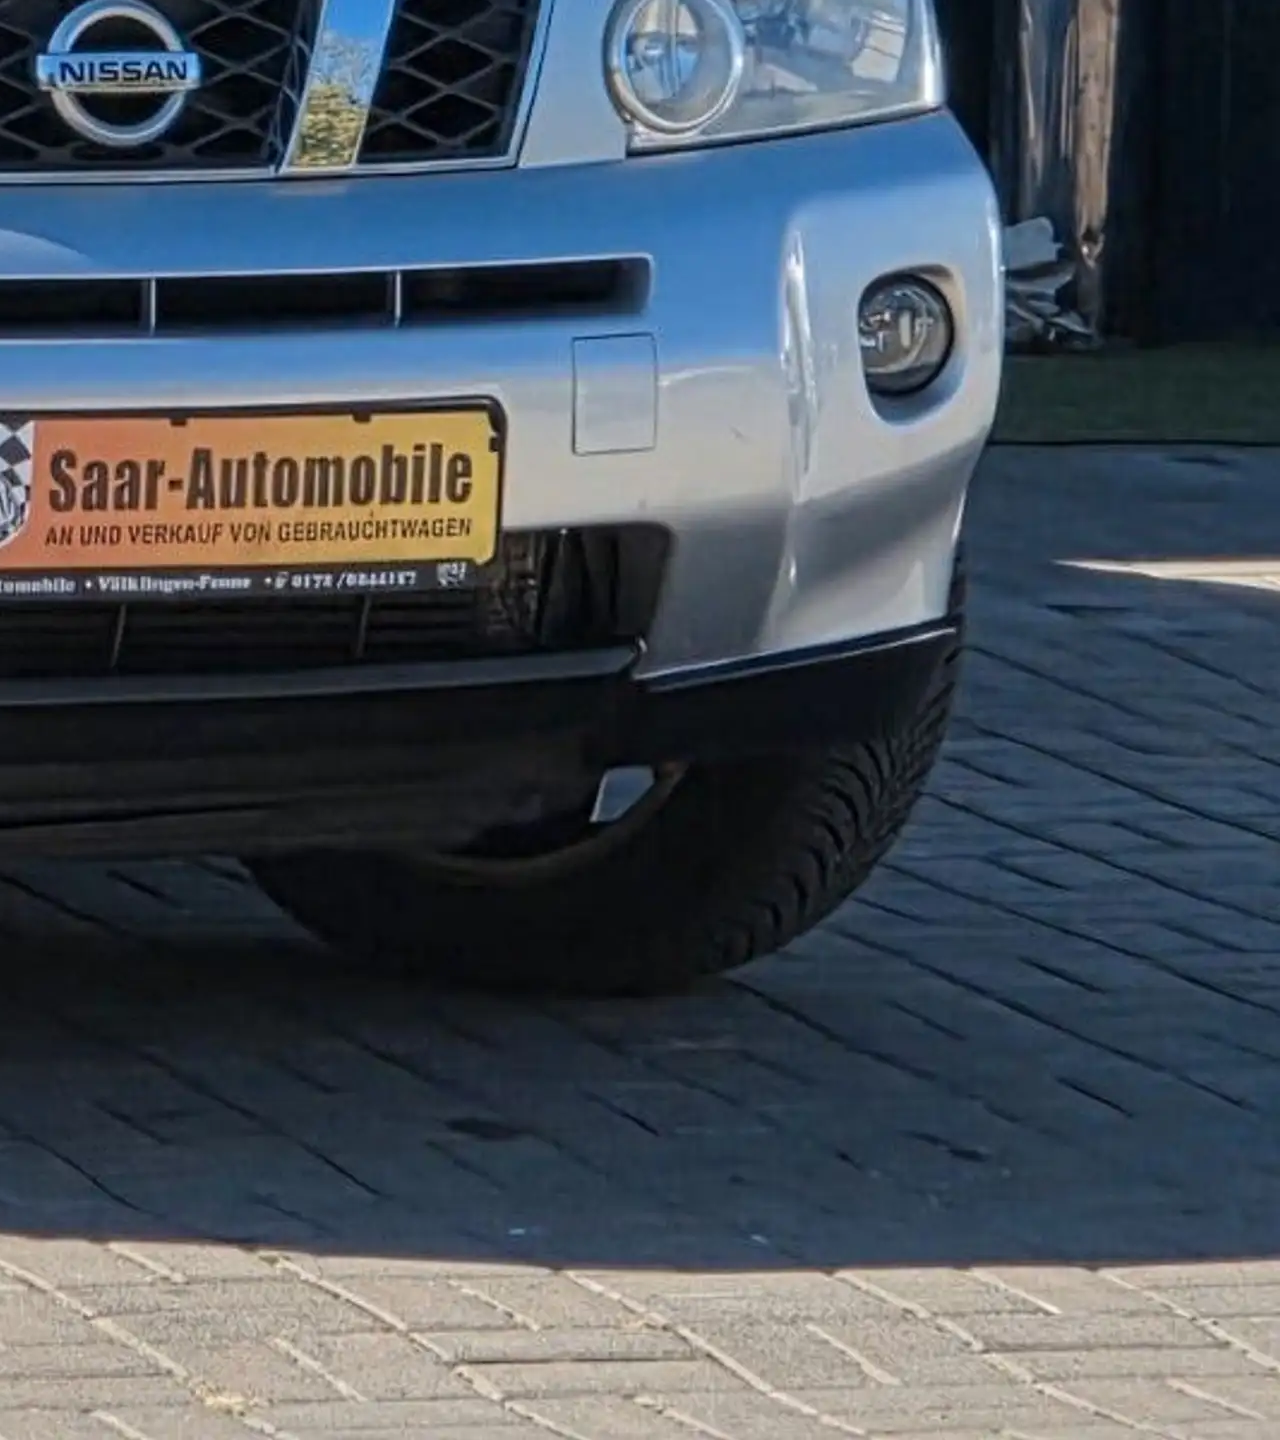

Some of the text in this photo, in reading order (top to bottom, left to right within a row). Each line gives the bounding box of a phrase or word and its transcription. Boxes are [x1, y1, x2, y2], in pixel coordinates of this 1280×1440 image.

[58, 60, 188, 82] NISSAN
[49, 443, 473, 512] Saar-Automobile
[45, 517, 473, 546] AN UND VERKAUF VON GEBRAUCHTWAGEN
